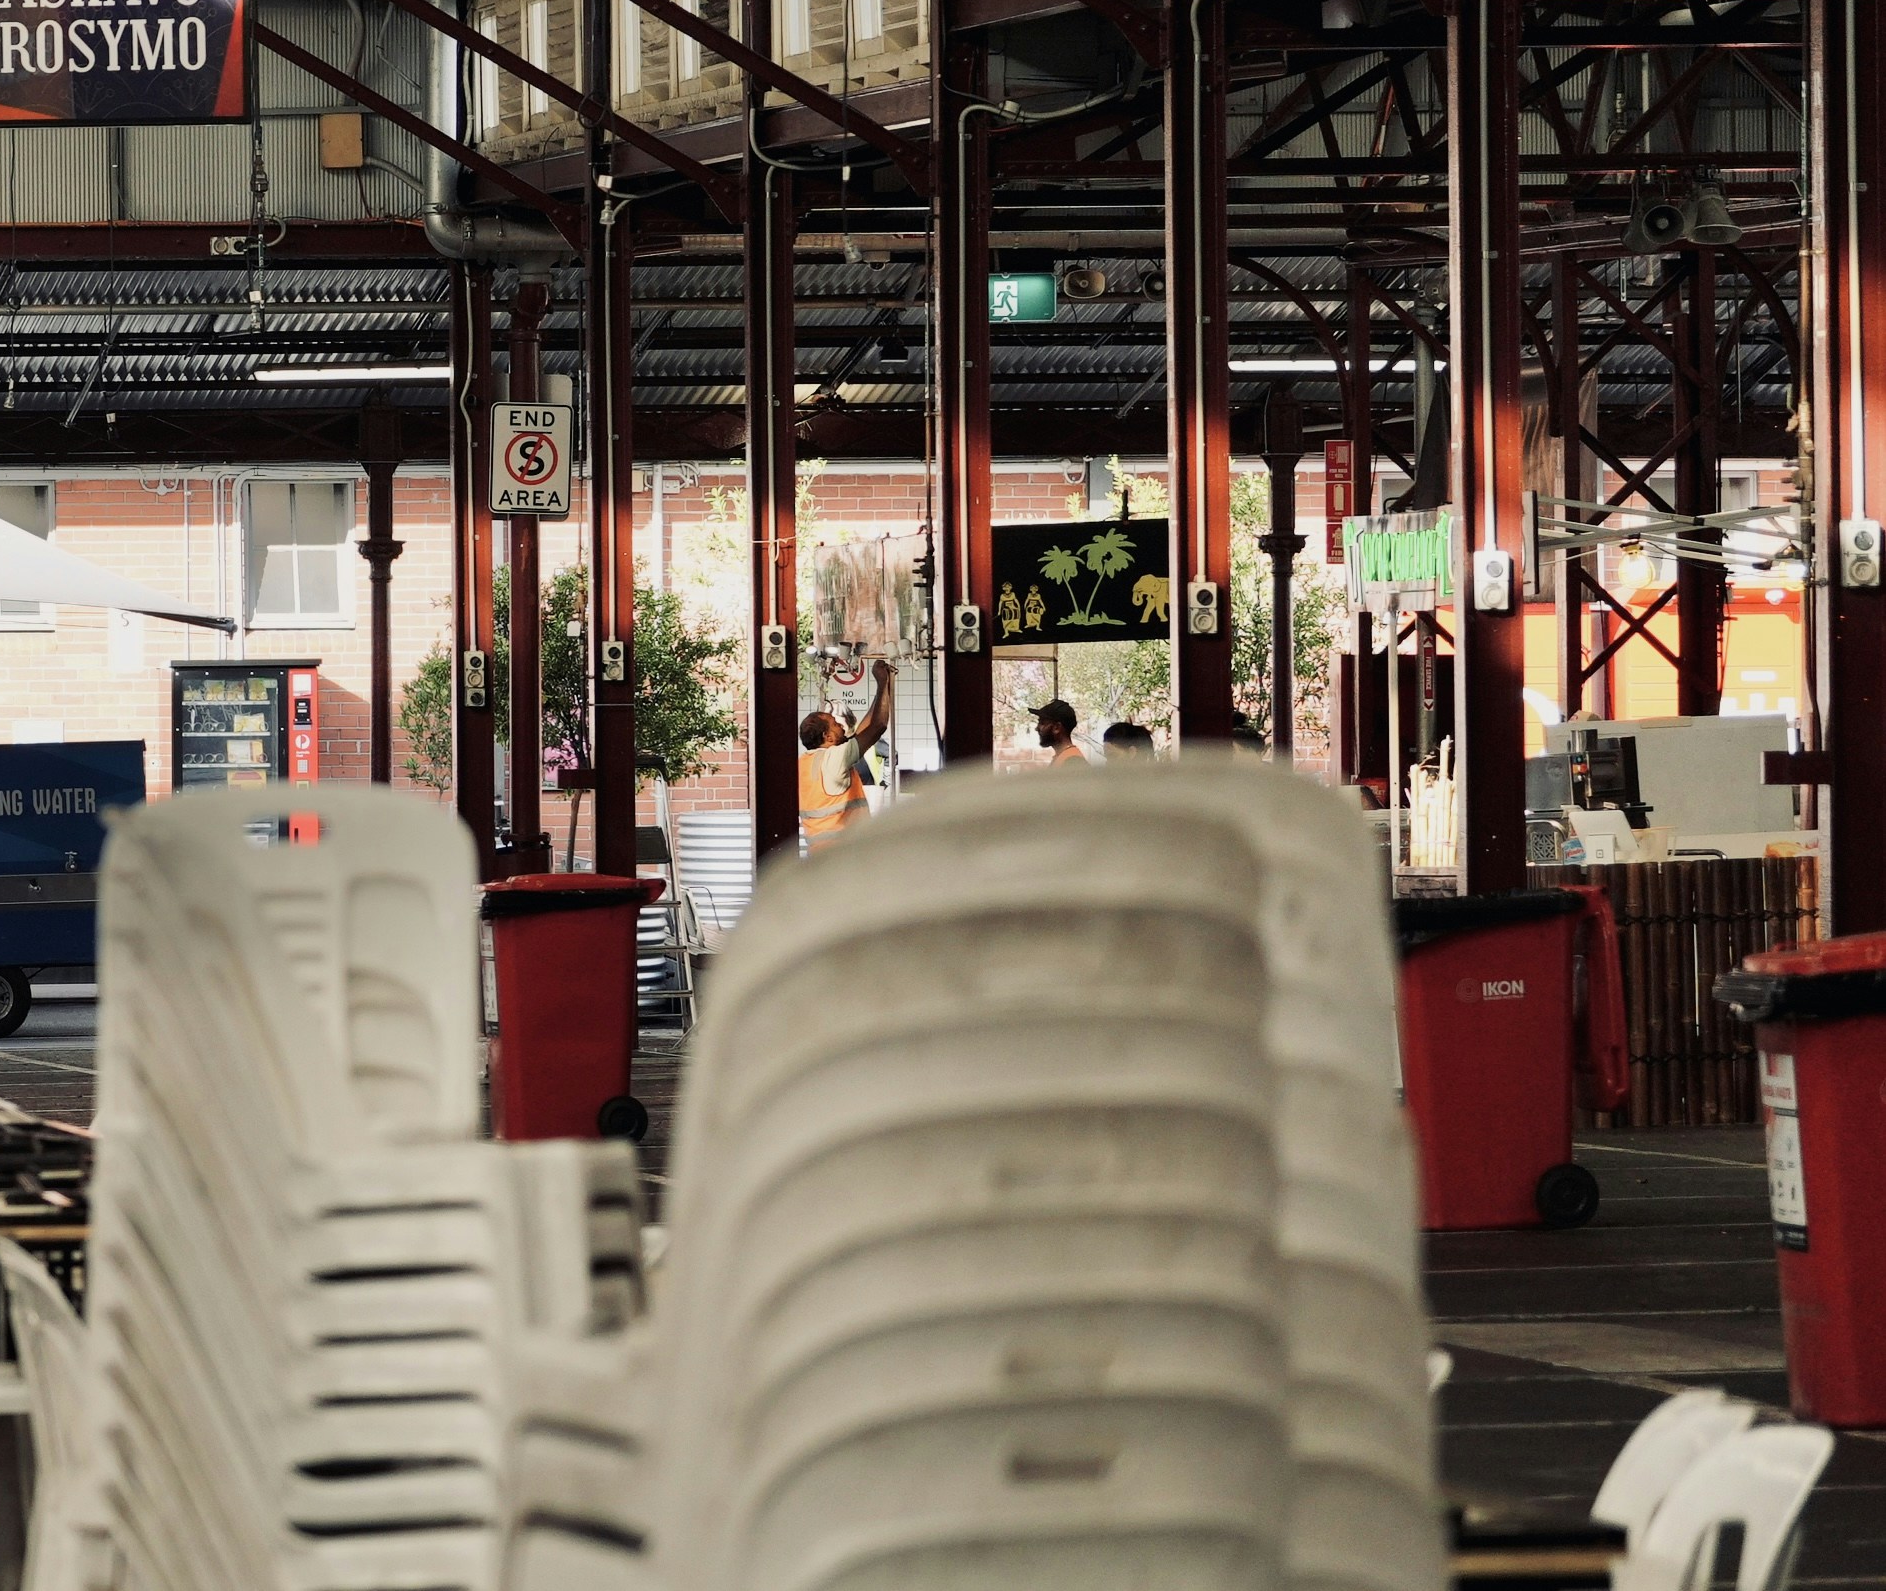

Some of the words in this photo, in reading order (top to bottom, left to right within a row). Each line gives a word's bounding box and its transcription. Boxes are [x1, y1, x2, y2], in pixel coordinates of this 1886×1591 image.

[510, 410, 555, 427] END
[498, 490, 562, 506] AREA
[842, 690, 854, 698] NO
[32, 787, 97, 815] WATER
[1482, 979, 1524, 997] IKON
